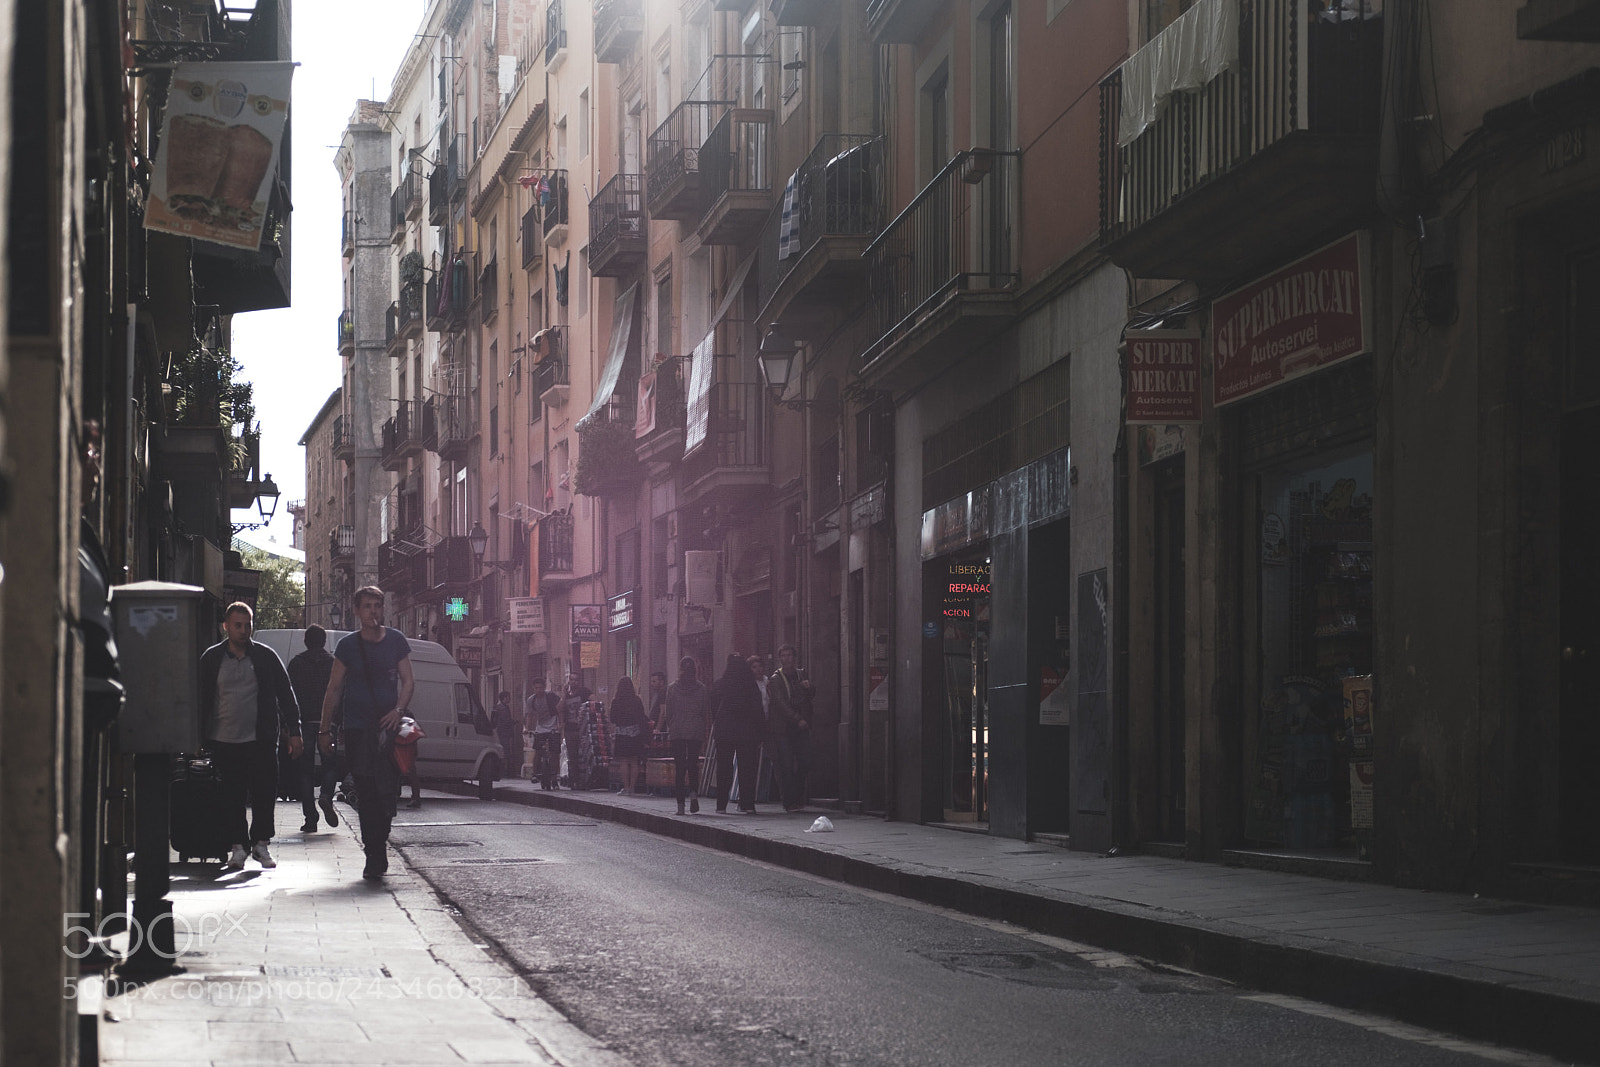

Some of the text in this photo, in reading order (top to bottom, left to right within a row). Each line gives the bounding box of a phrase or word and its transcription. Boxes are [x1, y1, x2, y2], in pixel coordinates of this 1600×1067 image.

[1218, 268, 1355, 370] SUPERMERCAT
[1133, 342, 1194, 365] SUPER
[1251, 319, 1317, 367] Autoservei
[1131, 370, 1197, 392] MERCAT
[1136, 396, 1193, 404] Autoservei
